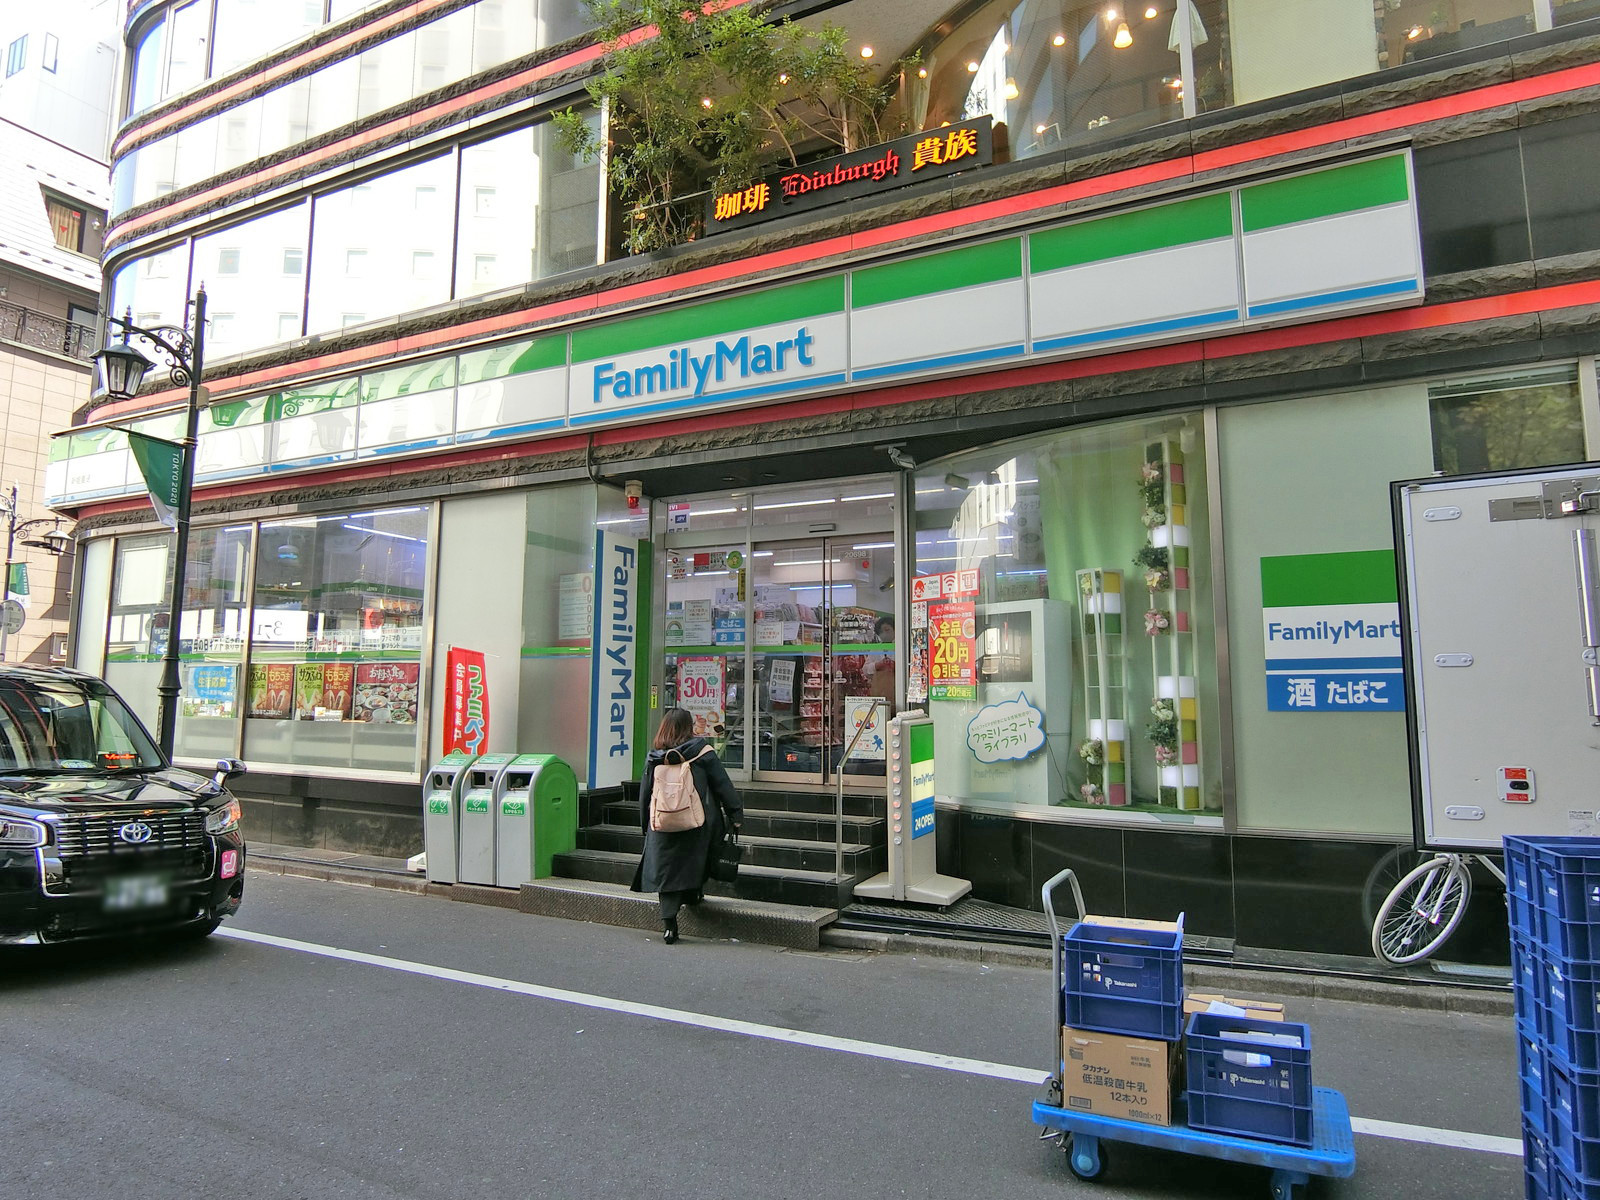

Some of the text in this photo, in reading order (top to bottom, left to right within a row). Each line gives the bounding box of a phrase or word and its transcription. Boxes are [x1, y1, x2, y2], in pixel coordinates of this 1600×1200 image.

[714, 129, 978, 222] 珈琲 Edinburgh 貴族
[593, 326, 814, 403] FamilyMart
[170, 482, 178, 504] 2020
[721, 620, 741, 628] たばこ
[940, 621, 961, 637] 全品
[1268, 619, 1400, 644] FamilyMart
[606, 544, 635, 757] FamilyMart
[934, 637, 969, 663] 20円
[269, 670, 290, 681] もちうま
[326, 670, 350, 681] もちうま
[942, 664, 960, 678] 引き
[1287, 678, 1389, 707] 酒 たばこ
[464, 665, 485, 755] ファミペイ
[973, 717, 1035, 743] ファミリーマート
[984, 732, 1027, 752] ライブラリ
[913, 772, 934, 787] FamilyMar
[1082, 1063, 1110, 1075] タカナシ
[1082, 1073, 1148, 1093] 低温殺菌牛乳
[1110, 1091, 1148, 1106] 12本入り
